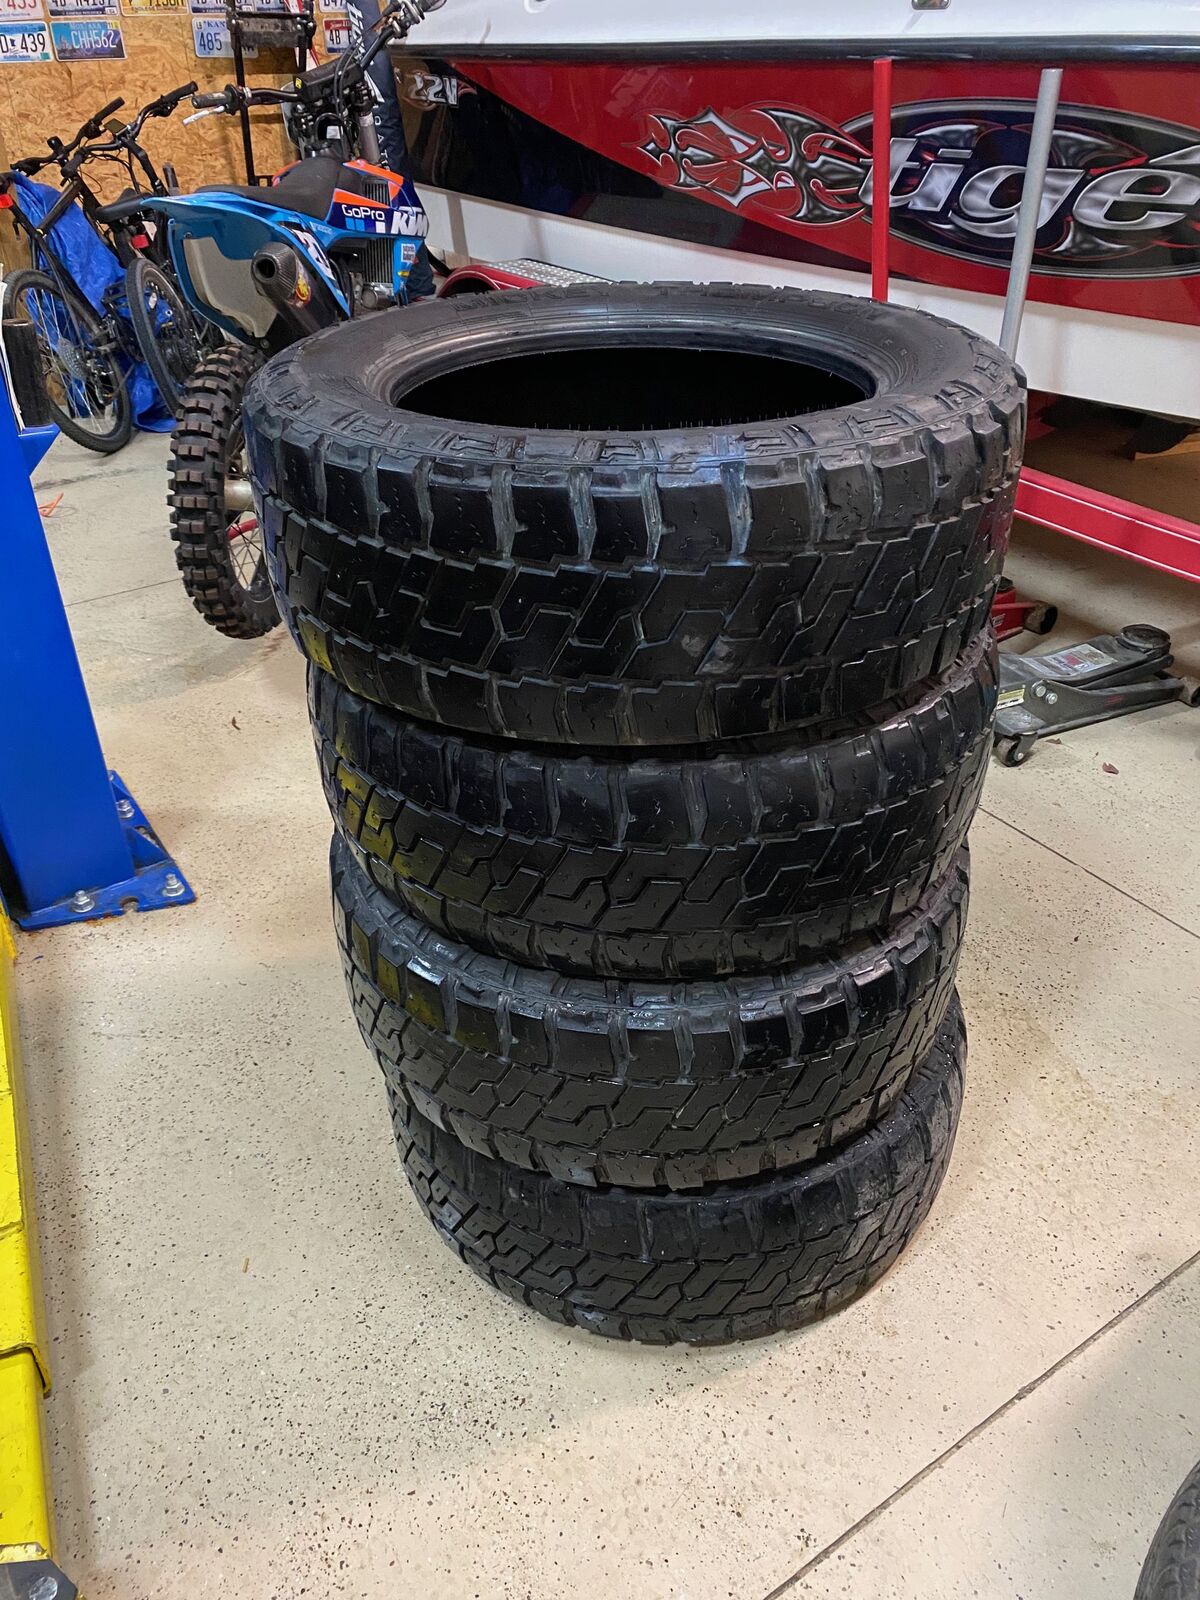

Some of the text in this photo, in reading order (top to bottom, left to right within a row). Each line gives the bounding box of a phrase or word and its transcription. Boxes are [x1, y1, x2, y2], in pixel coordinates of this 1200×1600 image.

[20, 32, 46, 54] 439
[71, 30, 117, 49] CHH562
[199, 31, 222, 52] 485
[341, 204, 386, 221] GoPro
[390, 206, 428, 237] KTM
